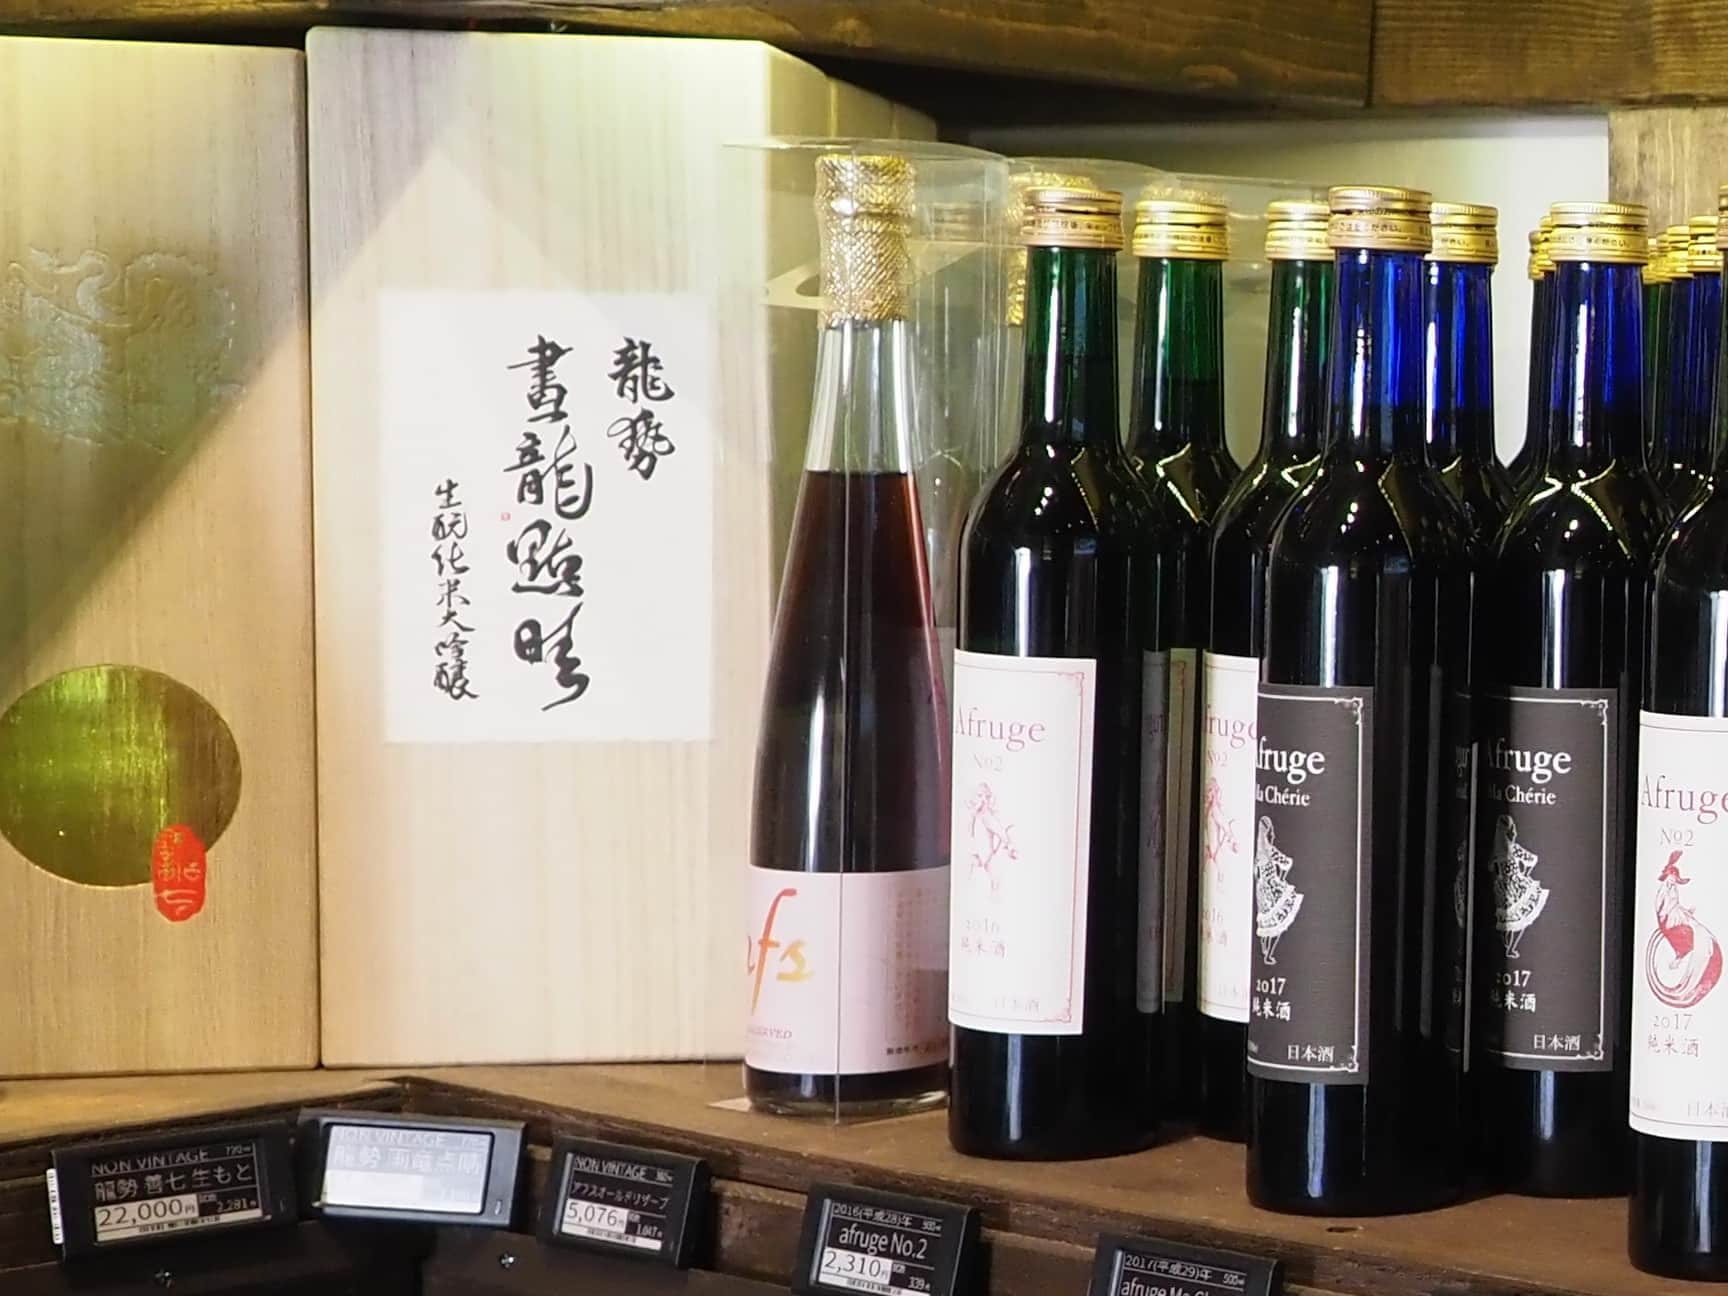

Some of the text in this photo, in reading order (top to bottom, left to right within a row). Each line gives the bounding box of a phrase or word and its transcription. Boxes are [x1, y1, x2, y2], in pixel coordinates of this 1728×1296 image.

[1288, 1044, 1335, 1063] 日本酒
[1533, 1033, 1581, 1052] 日本酒
[98, 1197, 196, 1227] 22,000円
[839, 1223, 928, 1260] afruge No.2
